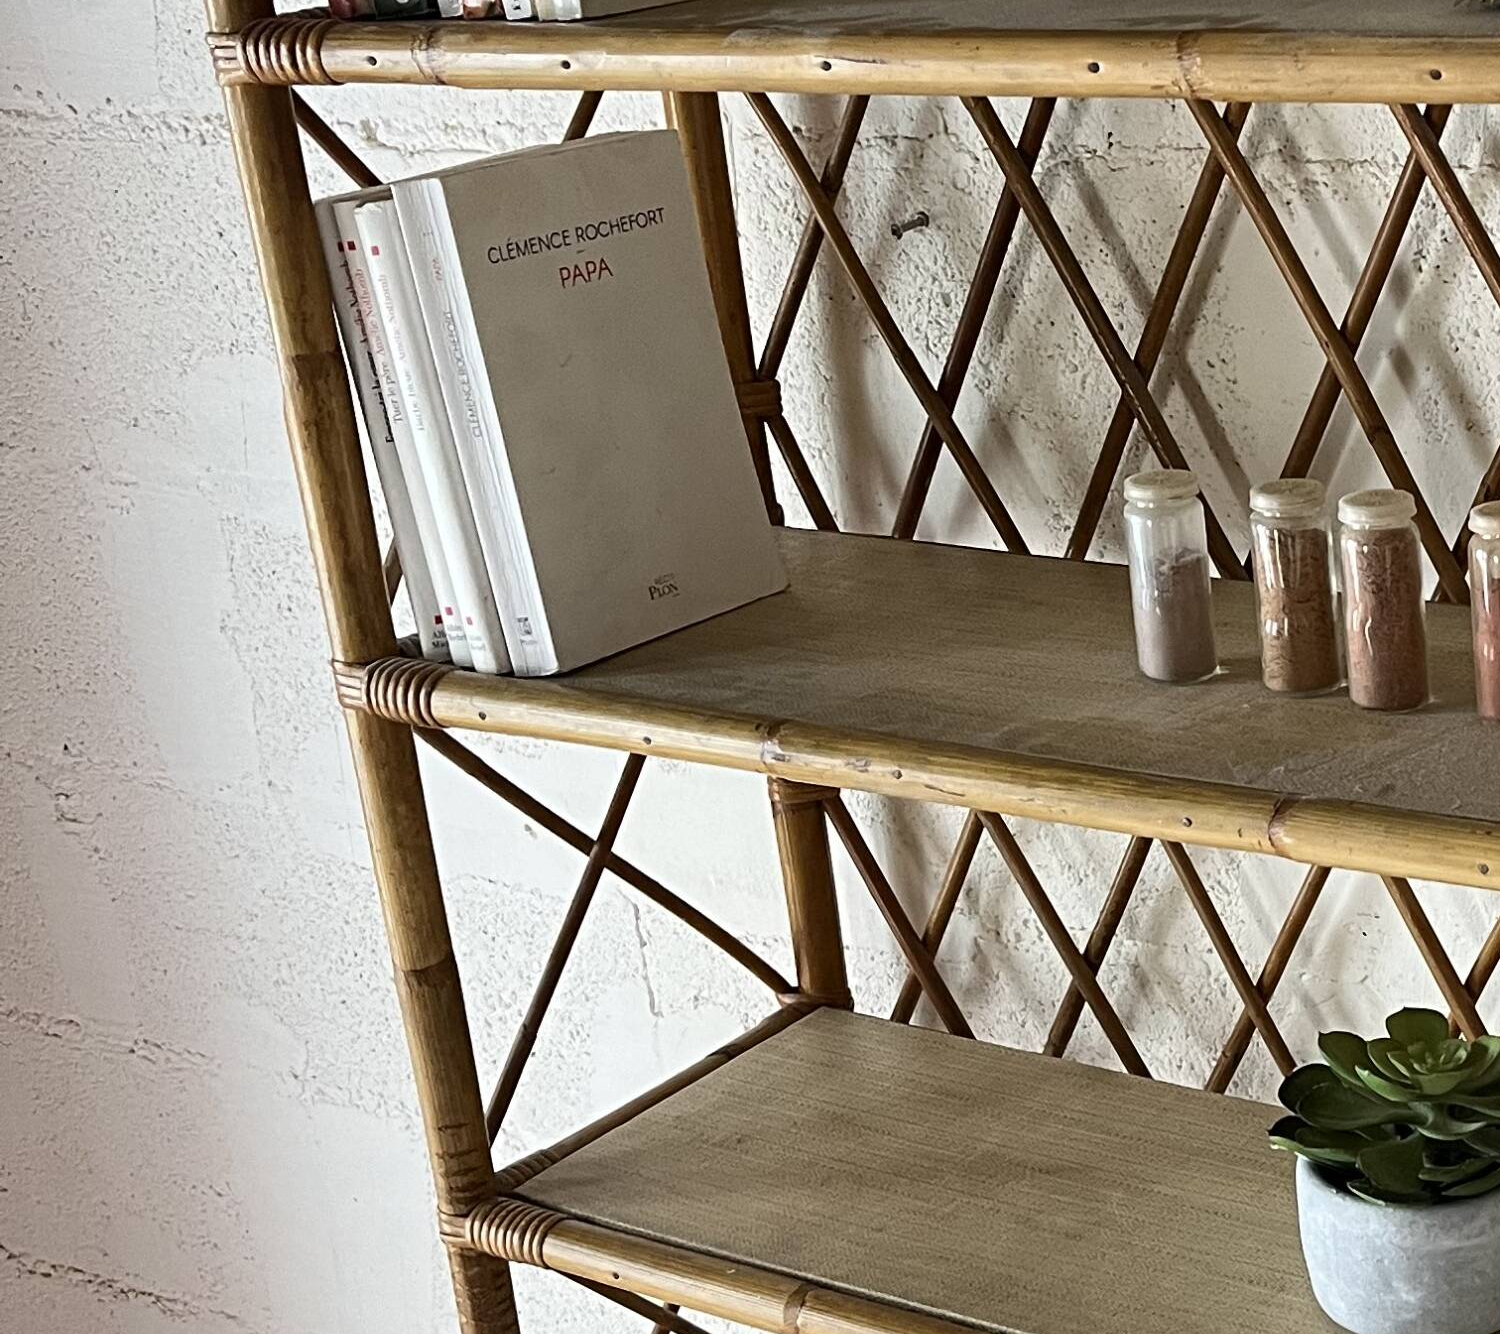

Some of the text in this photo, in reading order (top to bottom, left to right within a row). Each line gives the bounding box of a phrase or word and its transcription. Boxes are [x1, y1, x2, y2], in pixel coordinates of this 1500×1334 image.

[487, 207, 665, 265] CLÉMENCE ROCHEFORT
[355, 269, 373, 317] Nothomb
[558, 257, 613, 289] PAPA
[391, 399, 405, 424] Tuer
